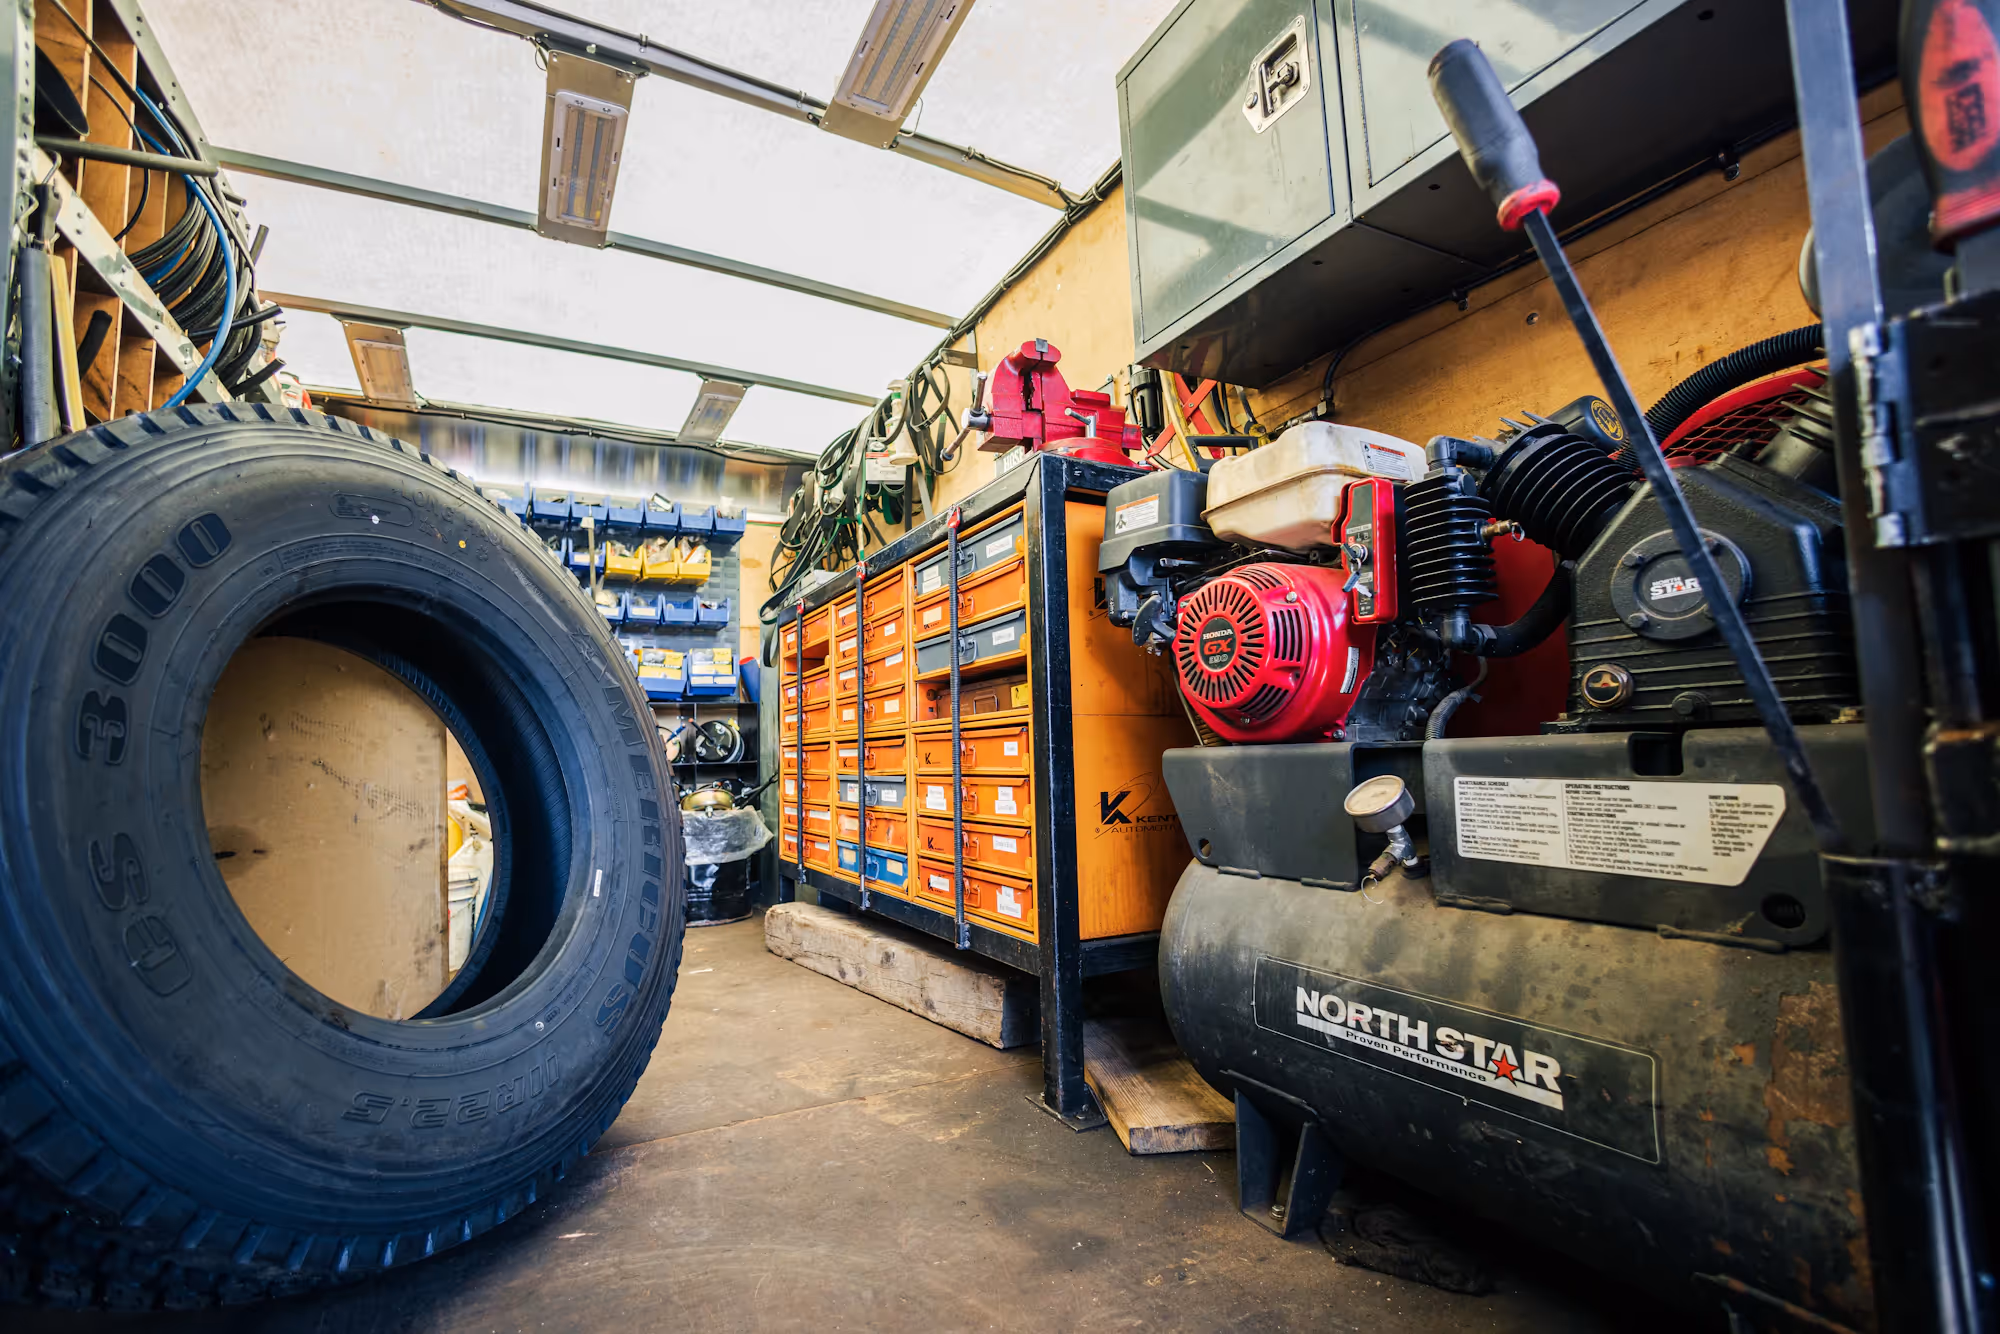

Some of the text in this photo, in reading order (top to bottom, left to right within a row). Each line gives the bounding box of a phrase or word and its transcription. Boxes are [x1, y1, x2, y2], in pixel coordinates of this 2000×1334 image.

[401, 481, 456, 524] LONG
[1650, 578, 1700, 596] STAR
[1652, 577, 1681, 586] NORTH
[74, 511, 232, 766] 3000
[1203, 629, 1233, 640] HONDA
[1204, 638, 1232, 655] GX
[1209, 654, 1228, 664] 390
[1136, 815, 1178, 823] KENT
[580, 634, 663, 1035] AMERICUS
[1296, 986, 1562, 1093] NORTH STAR
[1345, 1029, 1488, 1083] Proven Performance
[341, 1052, 561, 1129] 11R22.5
